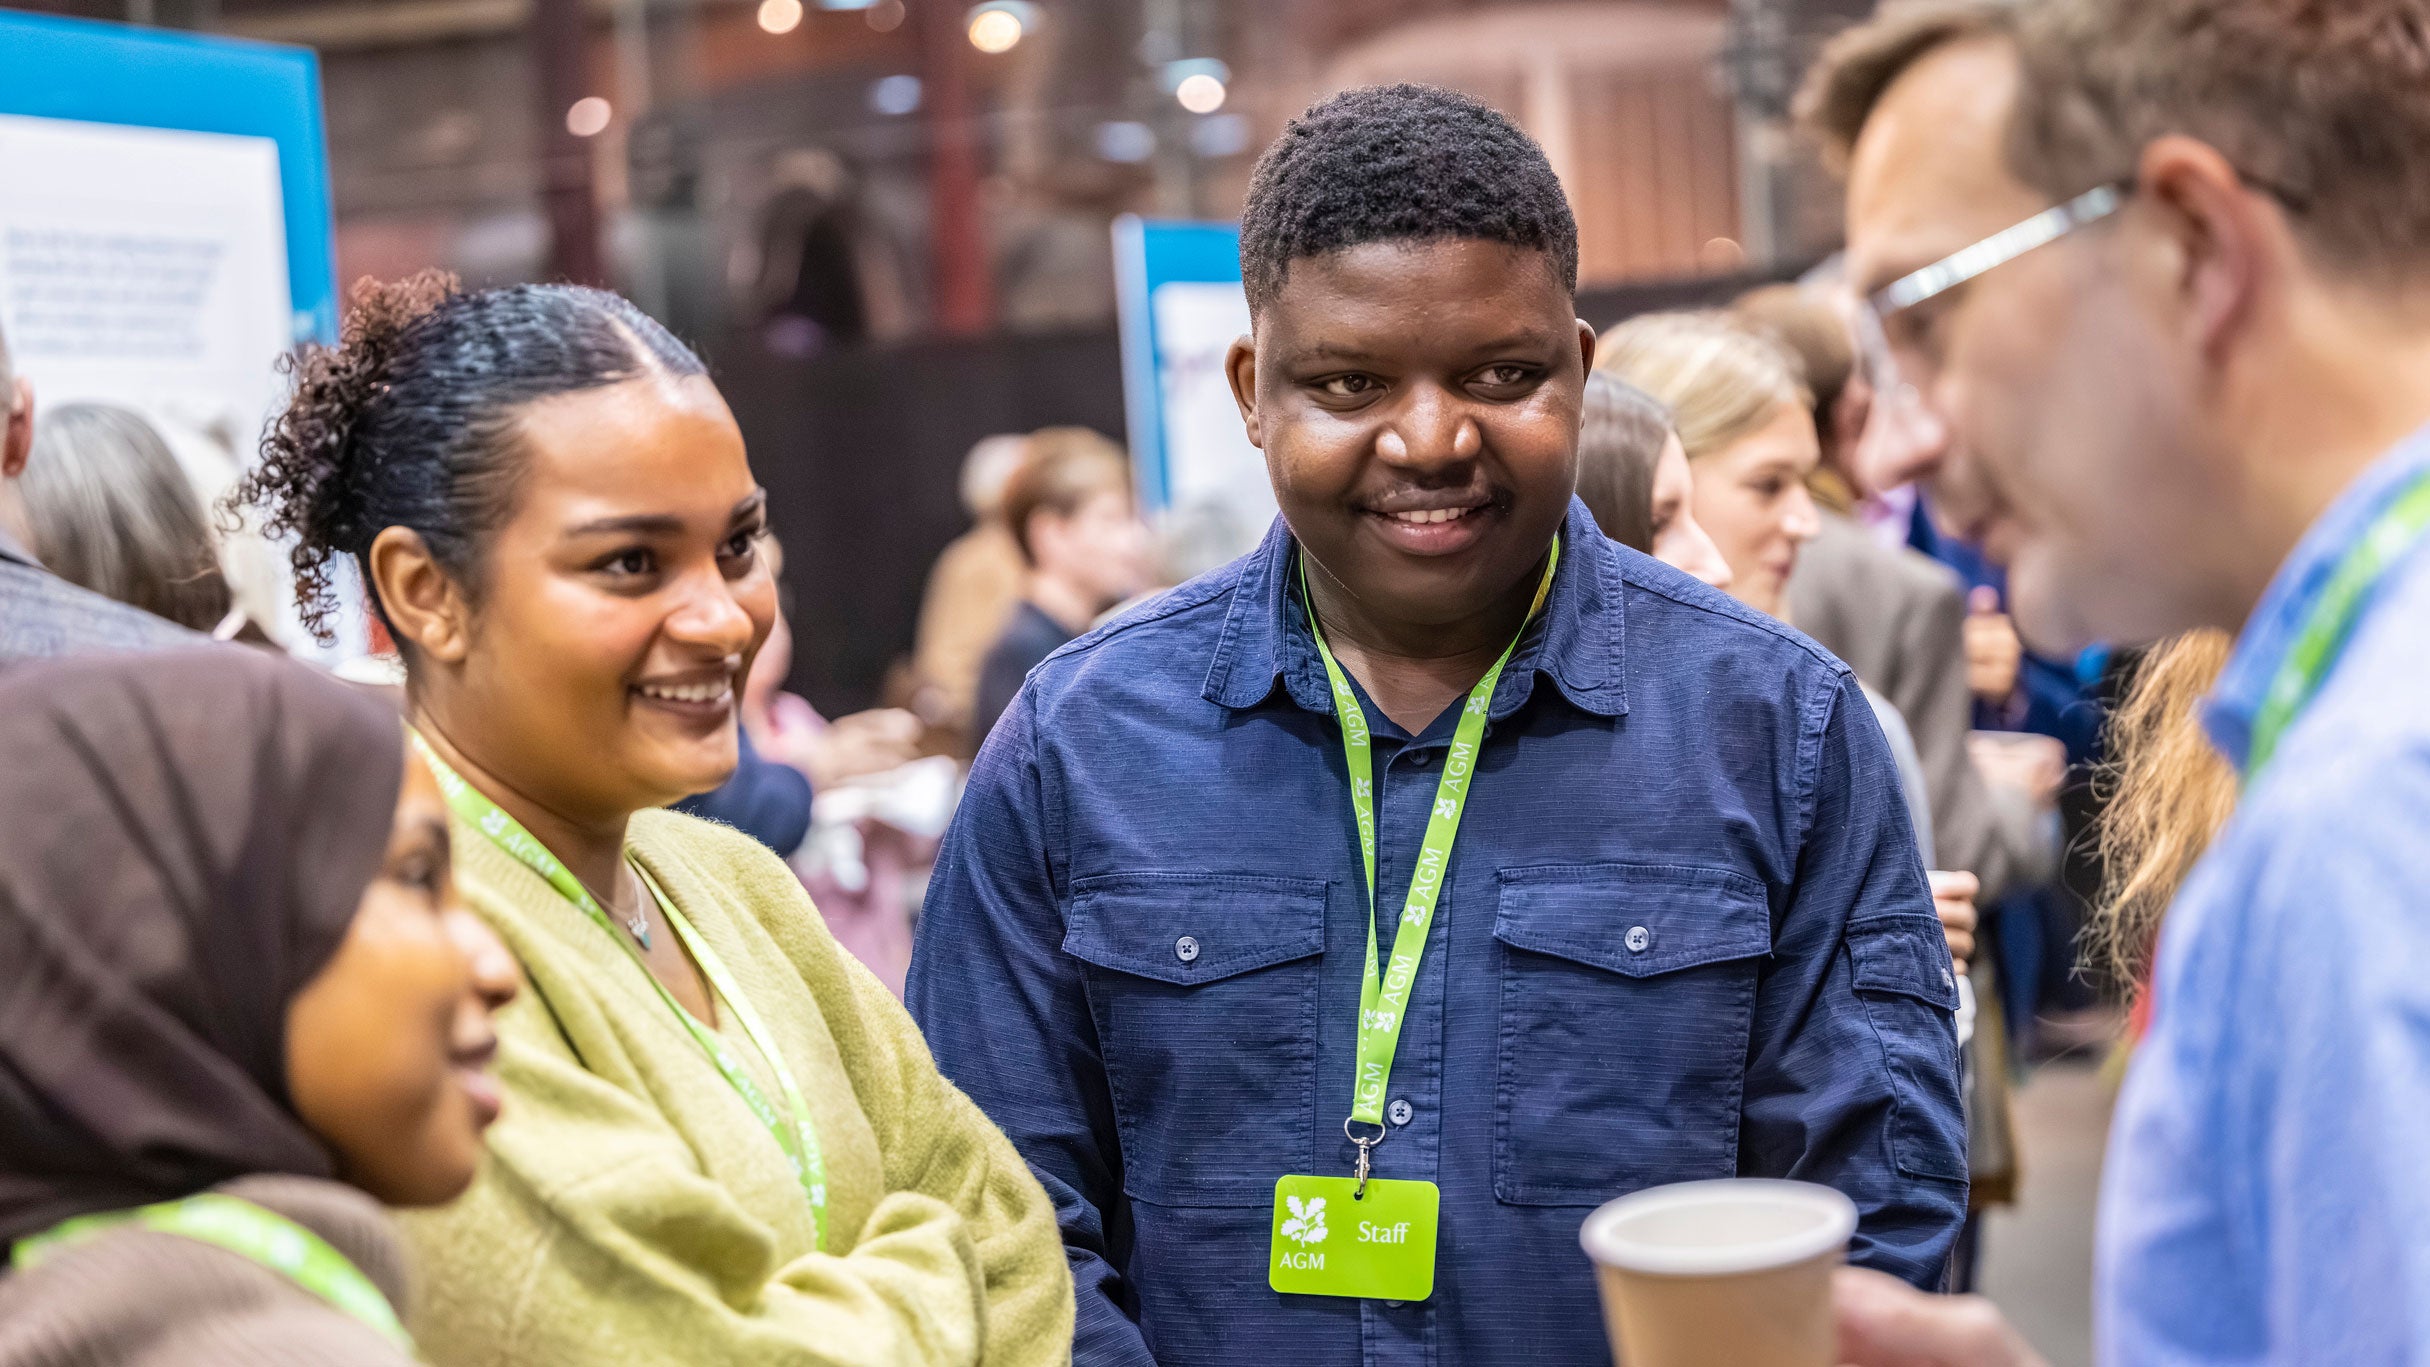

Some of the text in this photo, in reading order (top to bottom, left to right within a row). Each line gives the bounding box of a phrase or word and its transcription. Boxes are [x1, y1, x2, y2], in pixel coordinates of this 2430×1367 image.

[1343, 701, 1368, 747] AGM
[1444, 742, 1473, 793] AGM
[1414, 847, 1443, 900] AGM
[1383, 954, 1413, 1006] AGM
[1356, 1062, 1384, 1115] AGM
[1357, 1221, 1411, 1244] Staff
[1279, 1251, 1325, 1270] AGM
